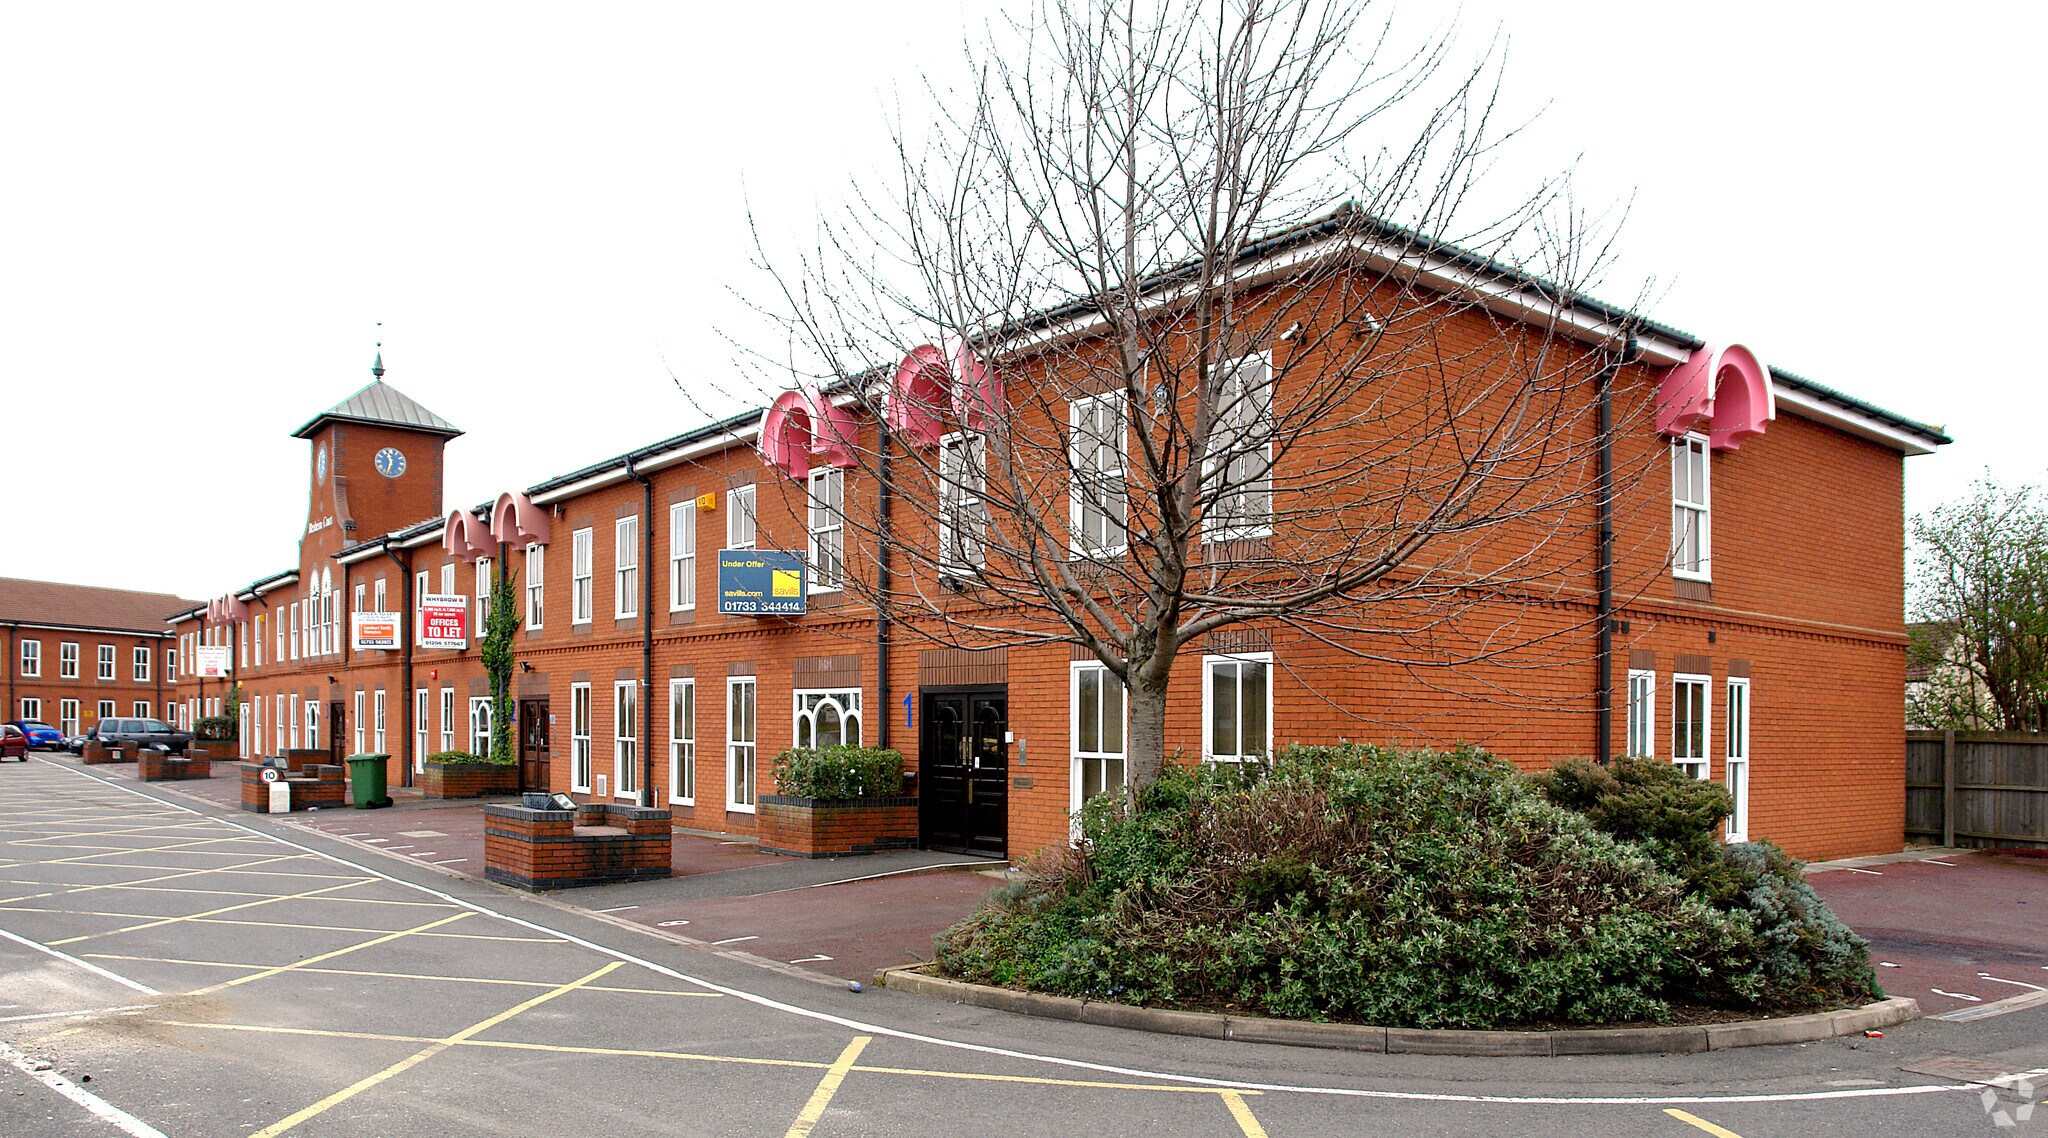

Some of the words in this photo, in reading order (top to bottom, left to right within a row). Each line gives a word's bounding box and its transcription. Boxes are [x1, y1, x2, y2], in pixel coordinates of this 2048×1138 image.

[722, 560, 745, 568] Under
[745, 560, 765, 568] Offer
[724, 589, 763, 597] savills.com
[774, 586, 799, 596] savills
[724, 601, 757, 611] 01733
[761, 602, 800, 612] 344414
[430, 618, 459, 627] OFFICES
[427, 626, 441, 637] TO
[443, 626, 462, 638] LET
[902, 691, 913, 729] 1
[264, 771, 275, 780] 10
